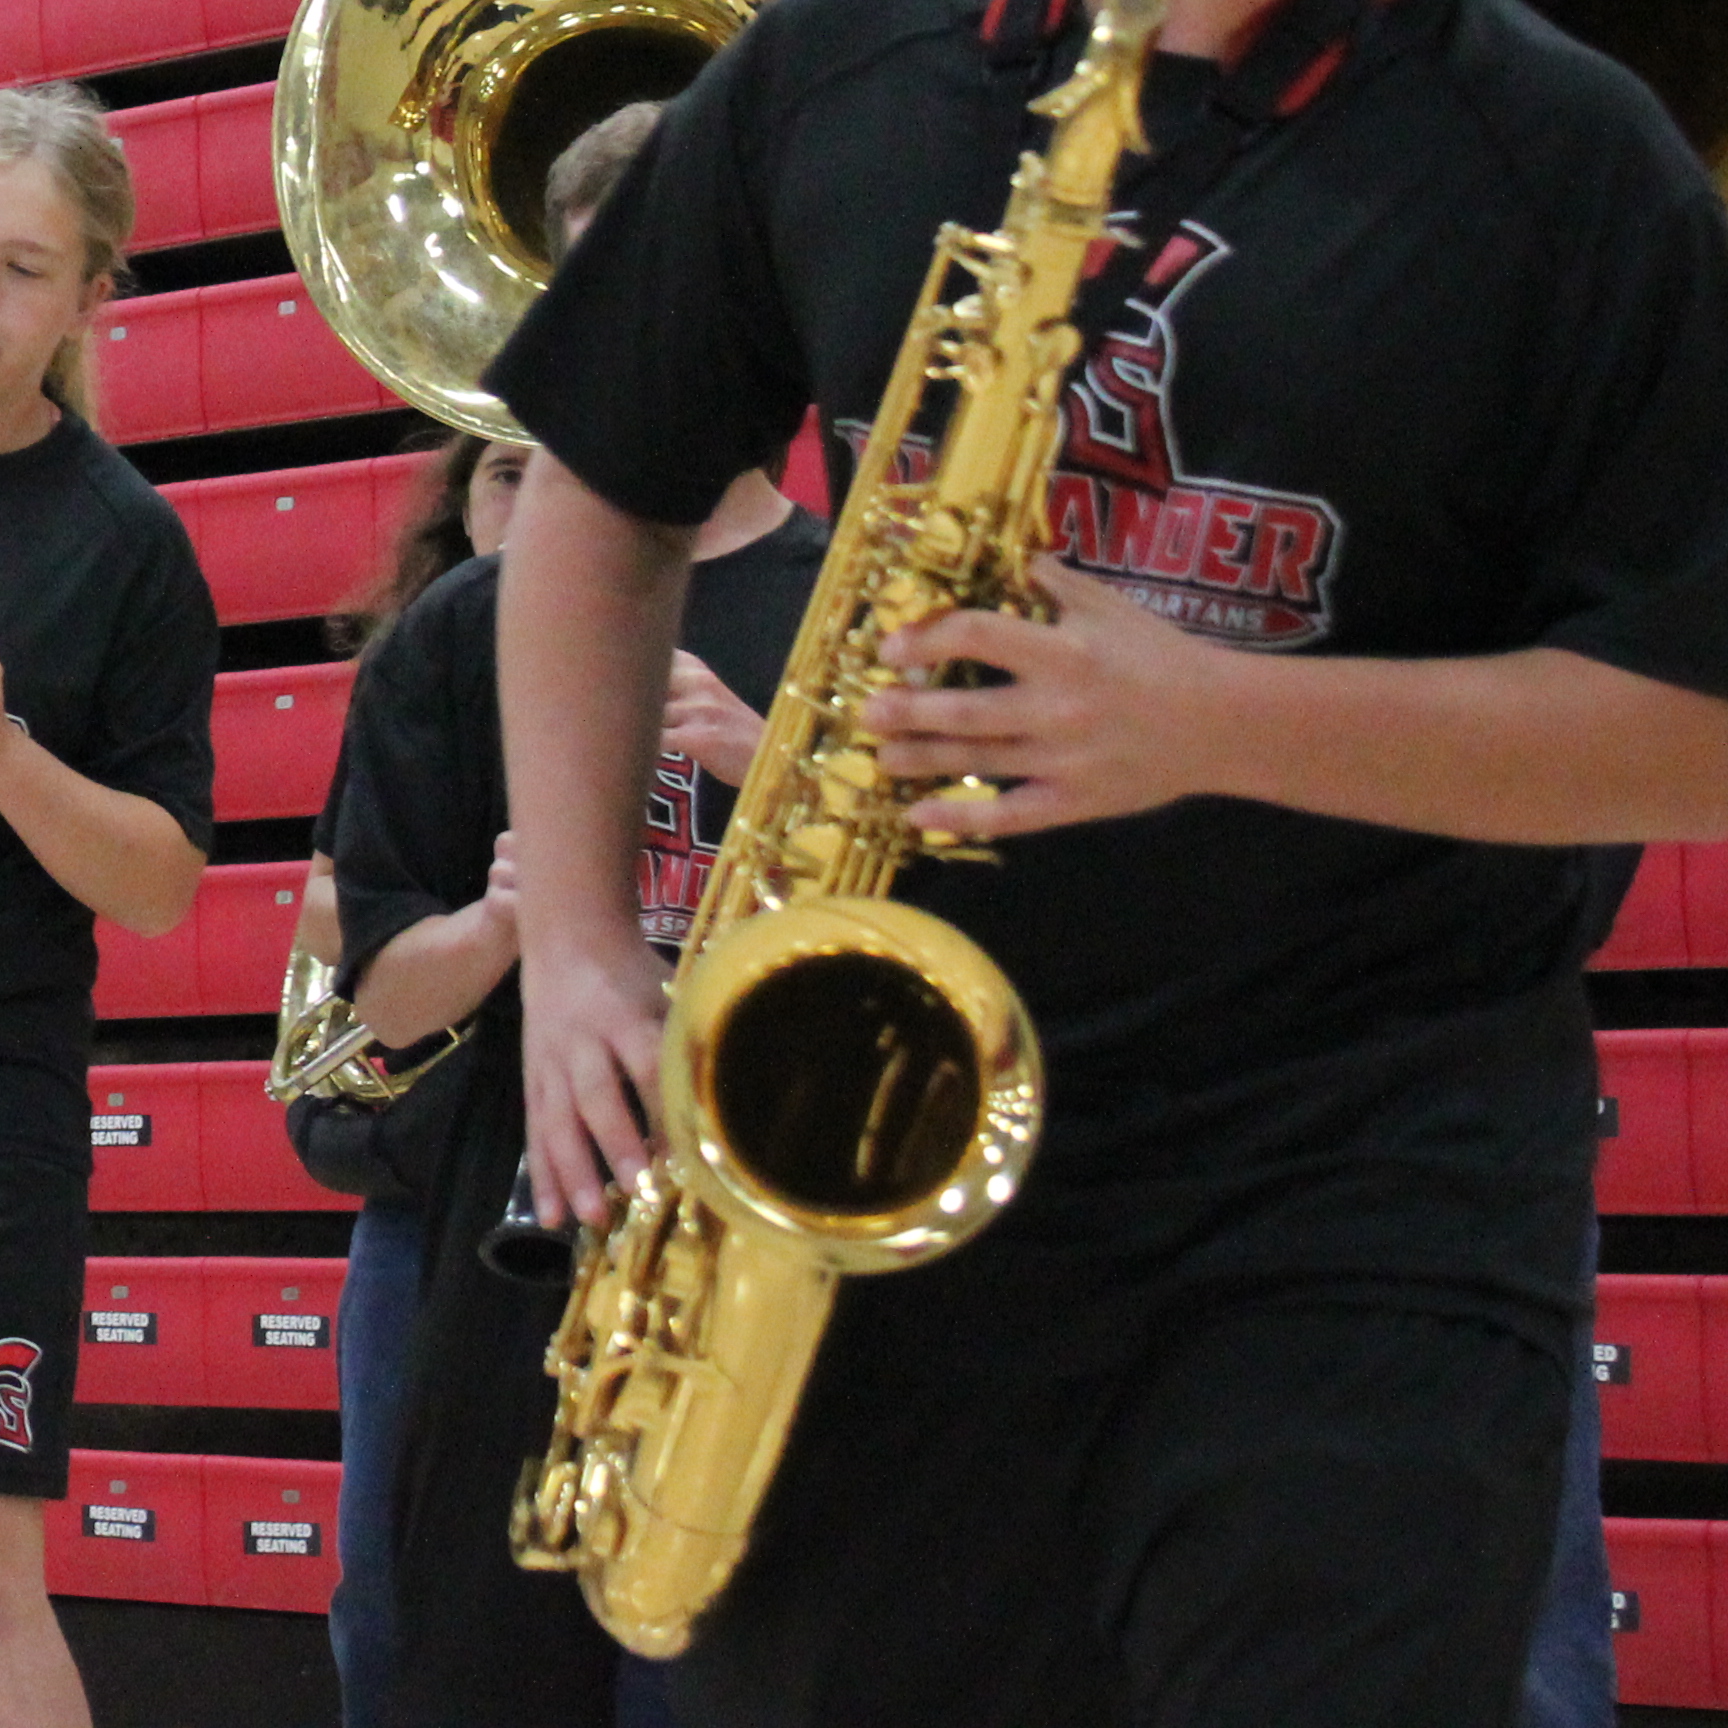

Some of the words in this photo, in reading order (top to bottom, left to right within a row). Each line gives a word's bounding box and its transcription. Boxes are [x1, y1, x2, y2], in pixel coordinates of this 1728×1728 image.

[91, 1131, 138, 1146] SEATING
[91, 1312, 149, 1328] RESERVED
[259, 1315, 321, 1331] RESERVED
[96, 1327, 144, 1342] SEATING
[265, 1331, 316, 1347] SEATING
[89, 1506, 146, 1524] RESERVED
[94, 1521, 142, 1540] SEATING
[250, 1522, 312, 1538] RESERVED
[256, 1538, 307, 1554] SEATING
